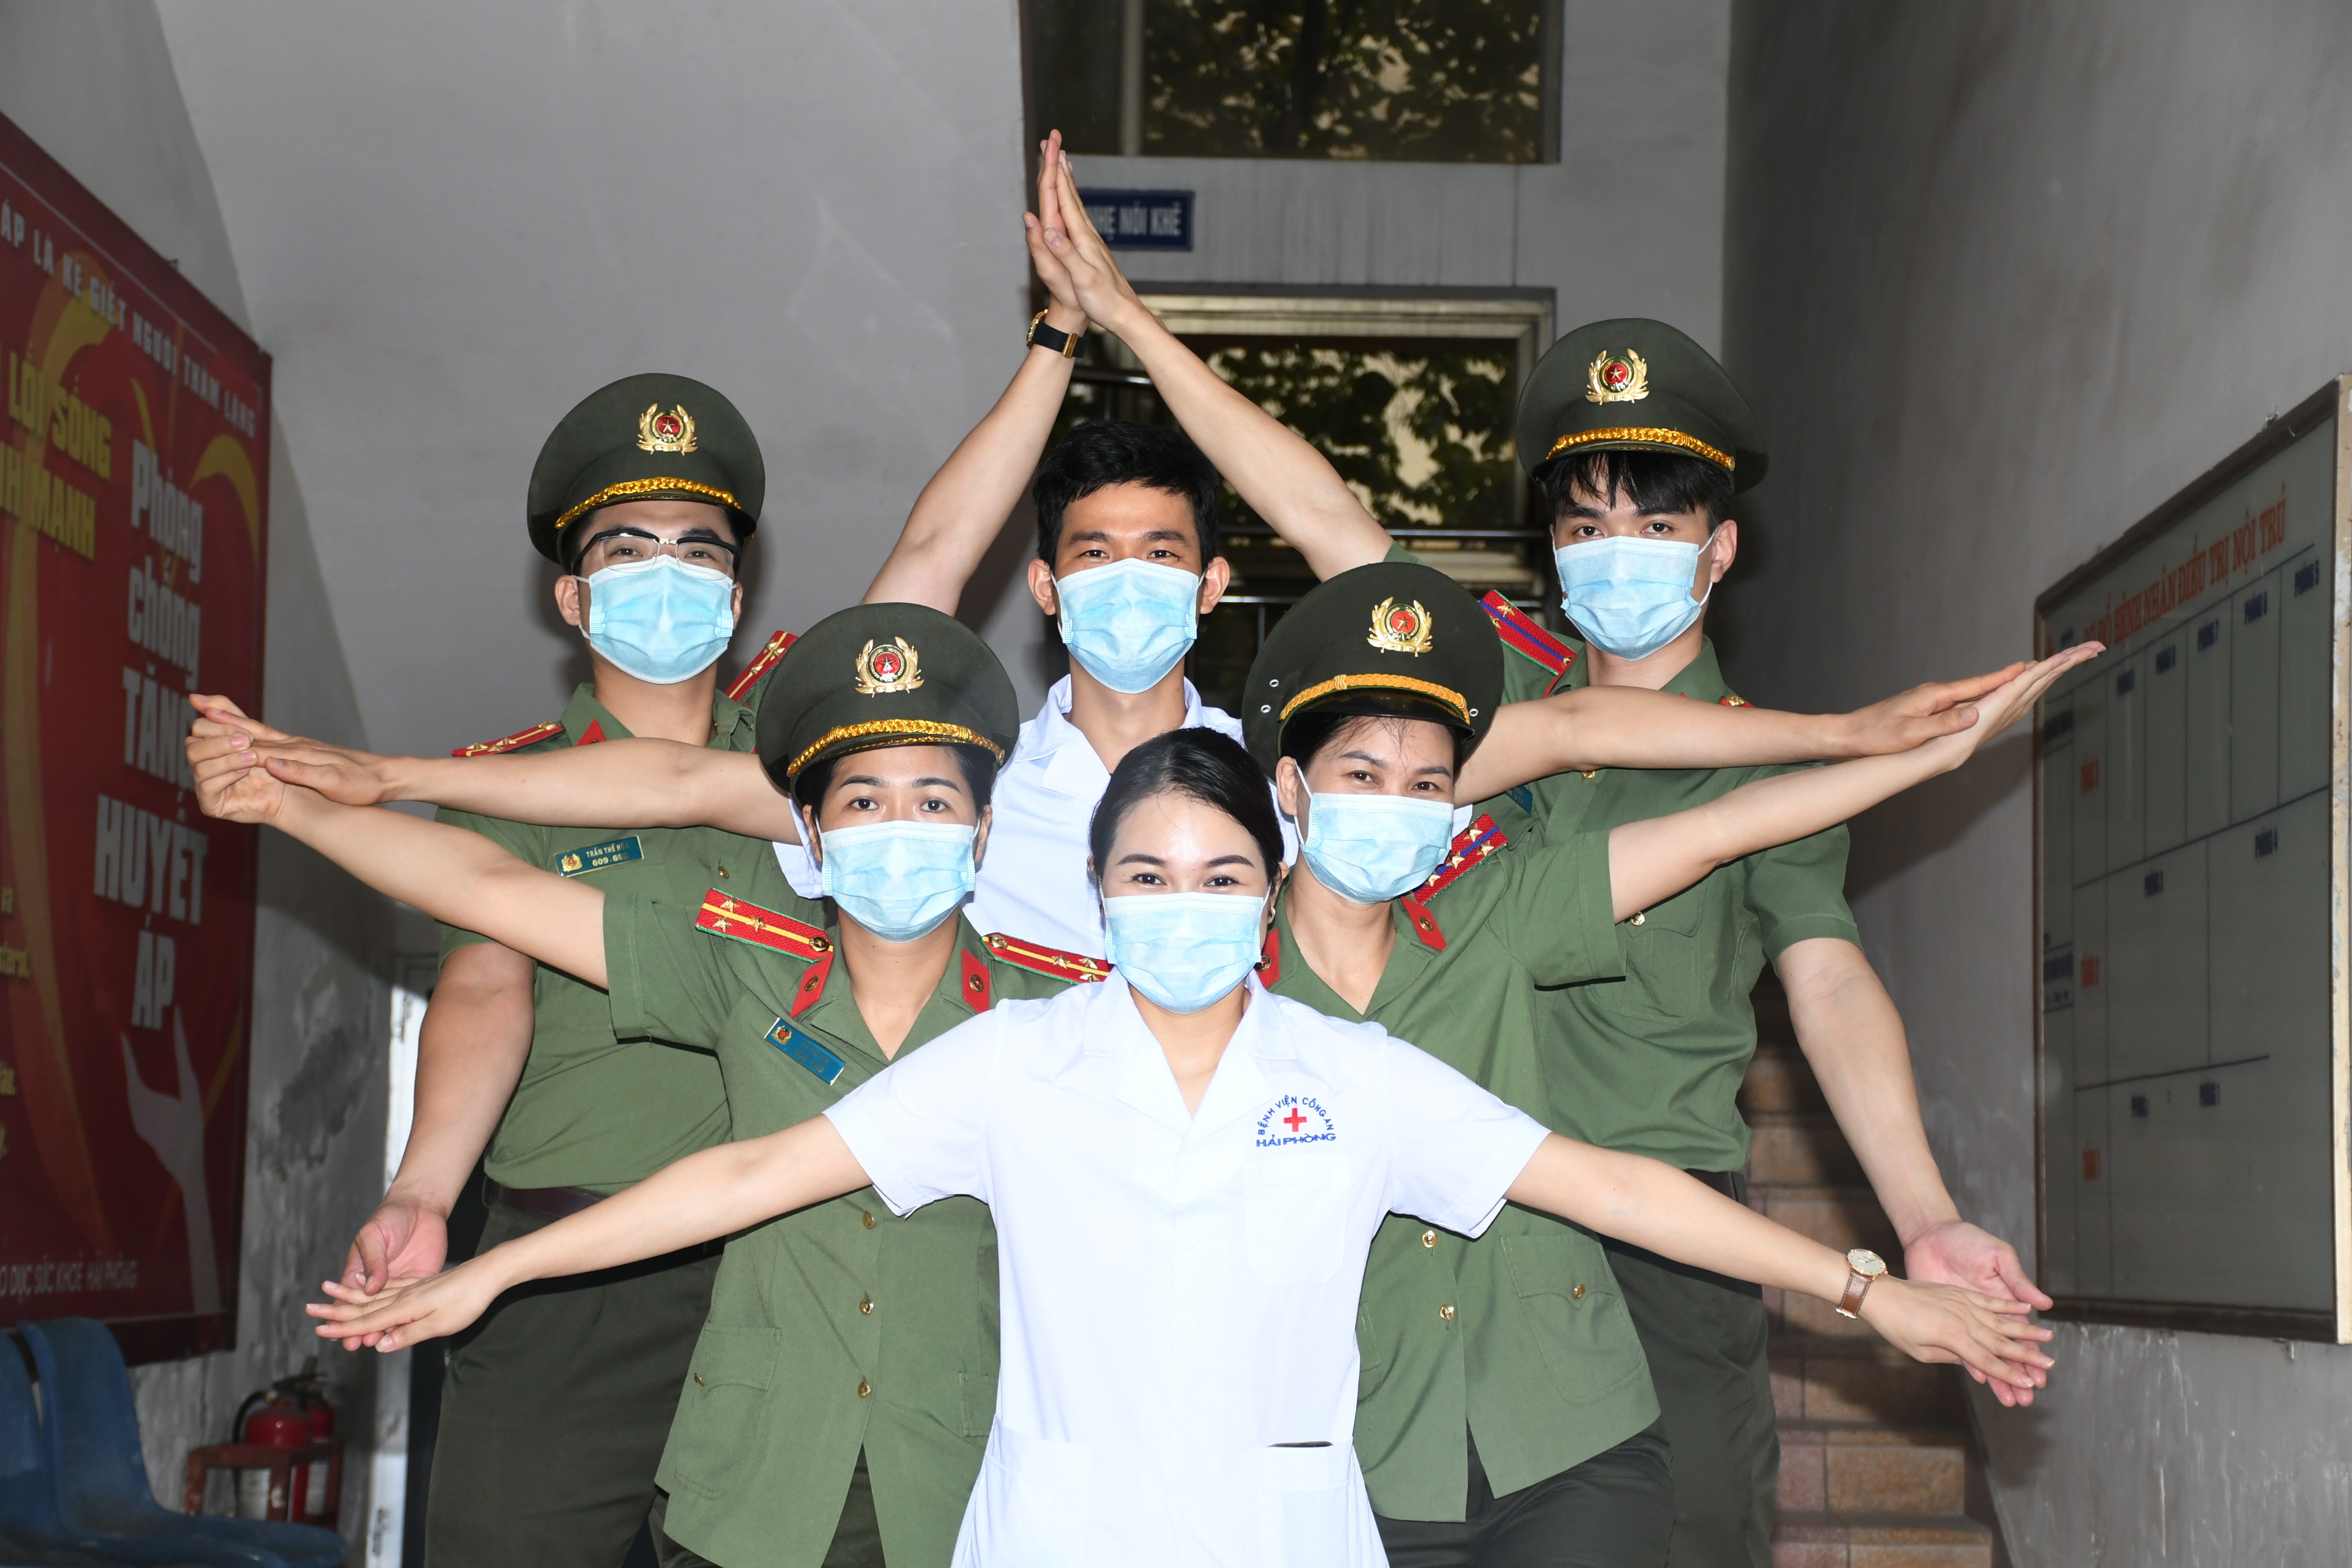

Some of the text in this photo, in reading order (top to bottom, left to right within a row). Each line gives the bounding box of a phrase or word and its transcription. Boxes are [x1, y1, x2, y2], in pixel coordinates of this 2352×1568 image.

[93, 790, 210, 926] HUYẾT
[131, 913, 176, 1031] ÁP
[1256, 1133, 1337, 1147] HẢI PHÒNG
[1257, 1094, 1334, 1135] BỆNH VIỆN CÔNG AN
